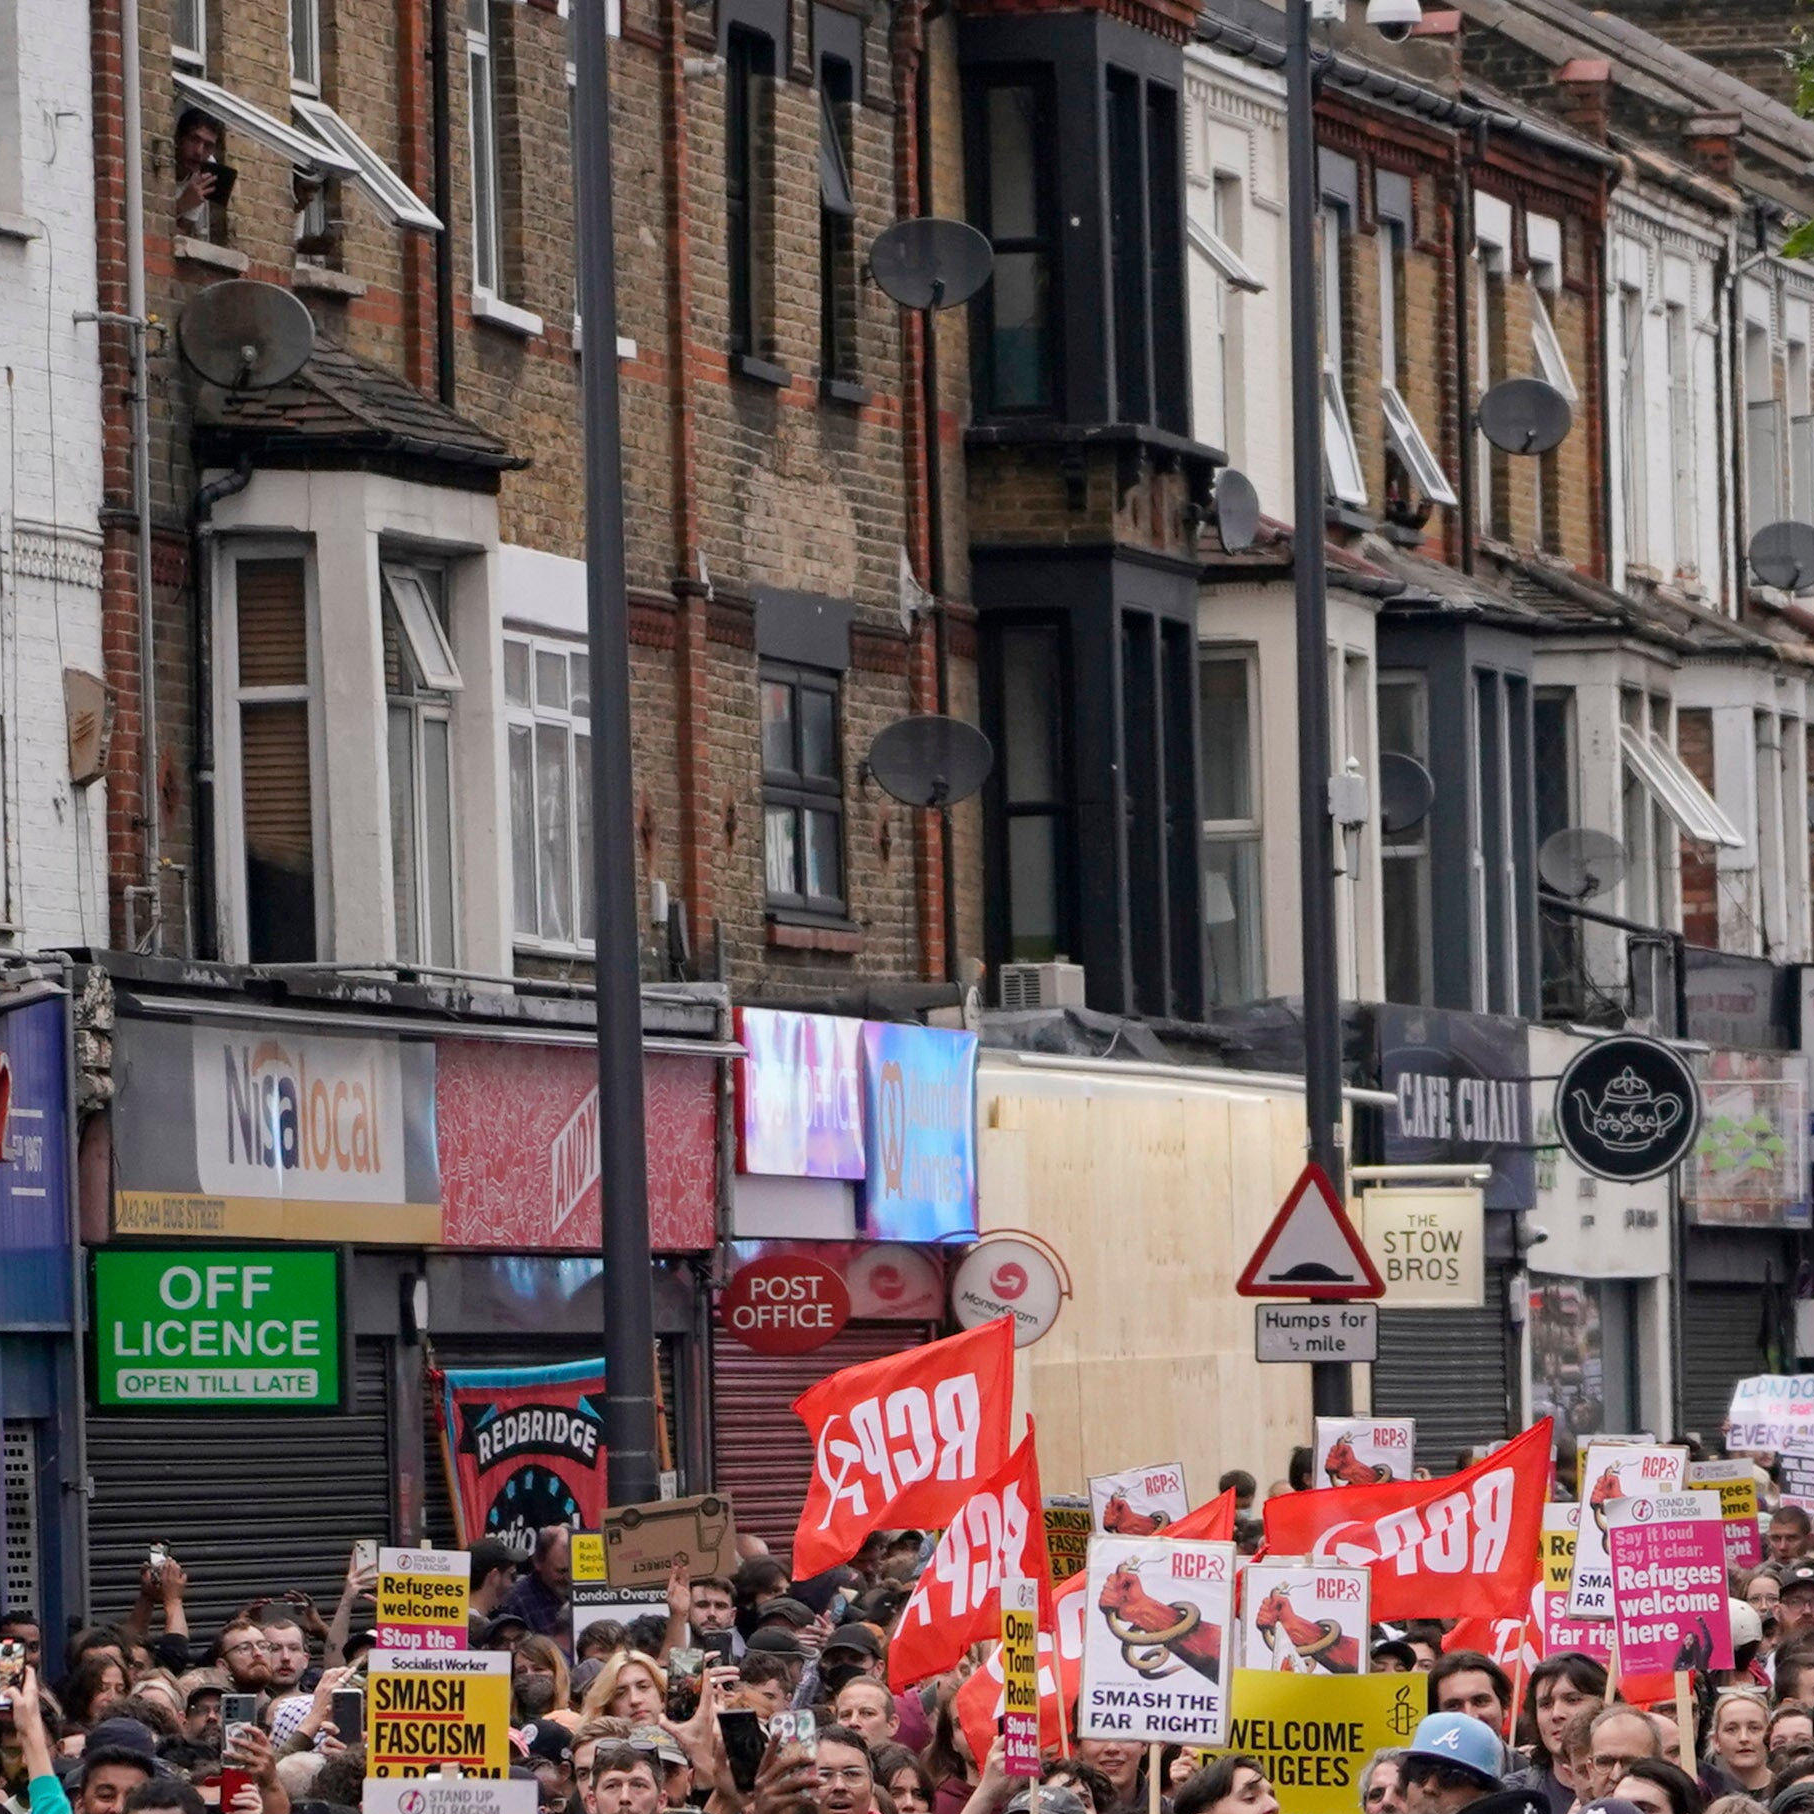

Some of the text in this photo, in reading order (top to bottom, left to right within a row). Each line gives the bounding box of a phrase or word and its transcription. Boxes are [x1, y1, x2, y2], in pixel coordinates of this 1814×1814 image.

[1398, 1072, 1451, 1139] CAFE
[1407, 1214, 1438, 1227] THE
[1384, 1231, 1462, 1254] STOW
[1387, 1258, 1459, 1282] BROS
[159, 1265, 273, 1310] OFF
[750, 1277, 823, 1300] POST
[732, 1304, 834, 1329] OFFICE
[962, 1291, 1038, 1325] MoneyGram
[1265, 1310, 1367, 1331] Humps for
[114, 1320, 320, 1356] LICENCE
[1306, 1336, 1346, 1352] mile
[124, 1375, 311, 1393] OPEN TILL LATE
[478, 1410, 598, 1465] REDBRIDGE
[1373, 1428, 1396, 1447] RCP
[1642, 1456, 1666, 1478] RCP
[1171, 1552, 1207, 1578] RCP
[383, 1577, 464, 1600] Refugees
[1317, 1578, 1347, 1600] RCP
[1618, 1563, 1723, 1592] Refugees
[573, 1588, 668, 1603] London Overgro
[1620, 1590, 1720, 1618] welcome
[383, 1600, 459, 1618] welcome
[381, 1627, 456, 1650] Stop the
[1622, 1620, 1679, 1646] here
[375, 1678, 465, 1711] SMASH
[1092, 1690, 1219, 1711] SMASH THE
[1090, 1713, 1217, 1734] FAR RIGHT!
[375, 1722, 485, 1755] FASCISM
[1228, 1719, 1364, 1752] WELCOME
[429, 1790, 493, 1803] STAND UP
